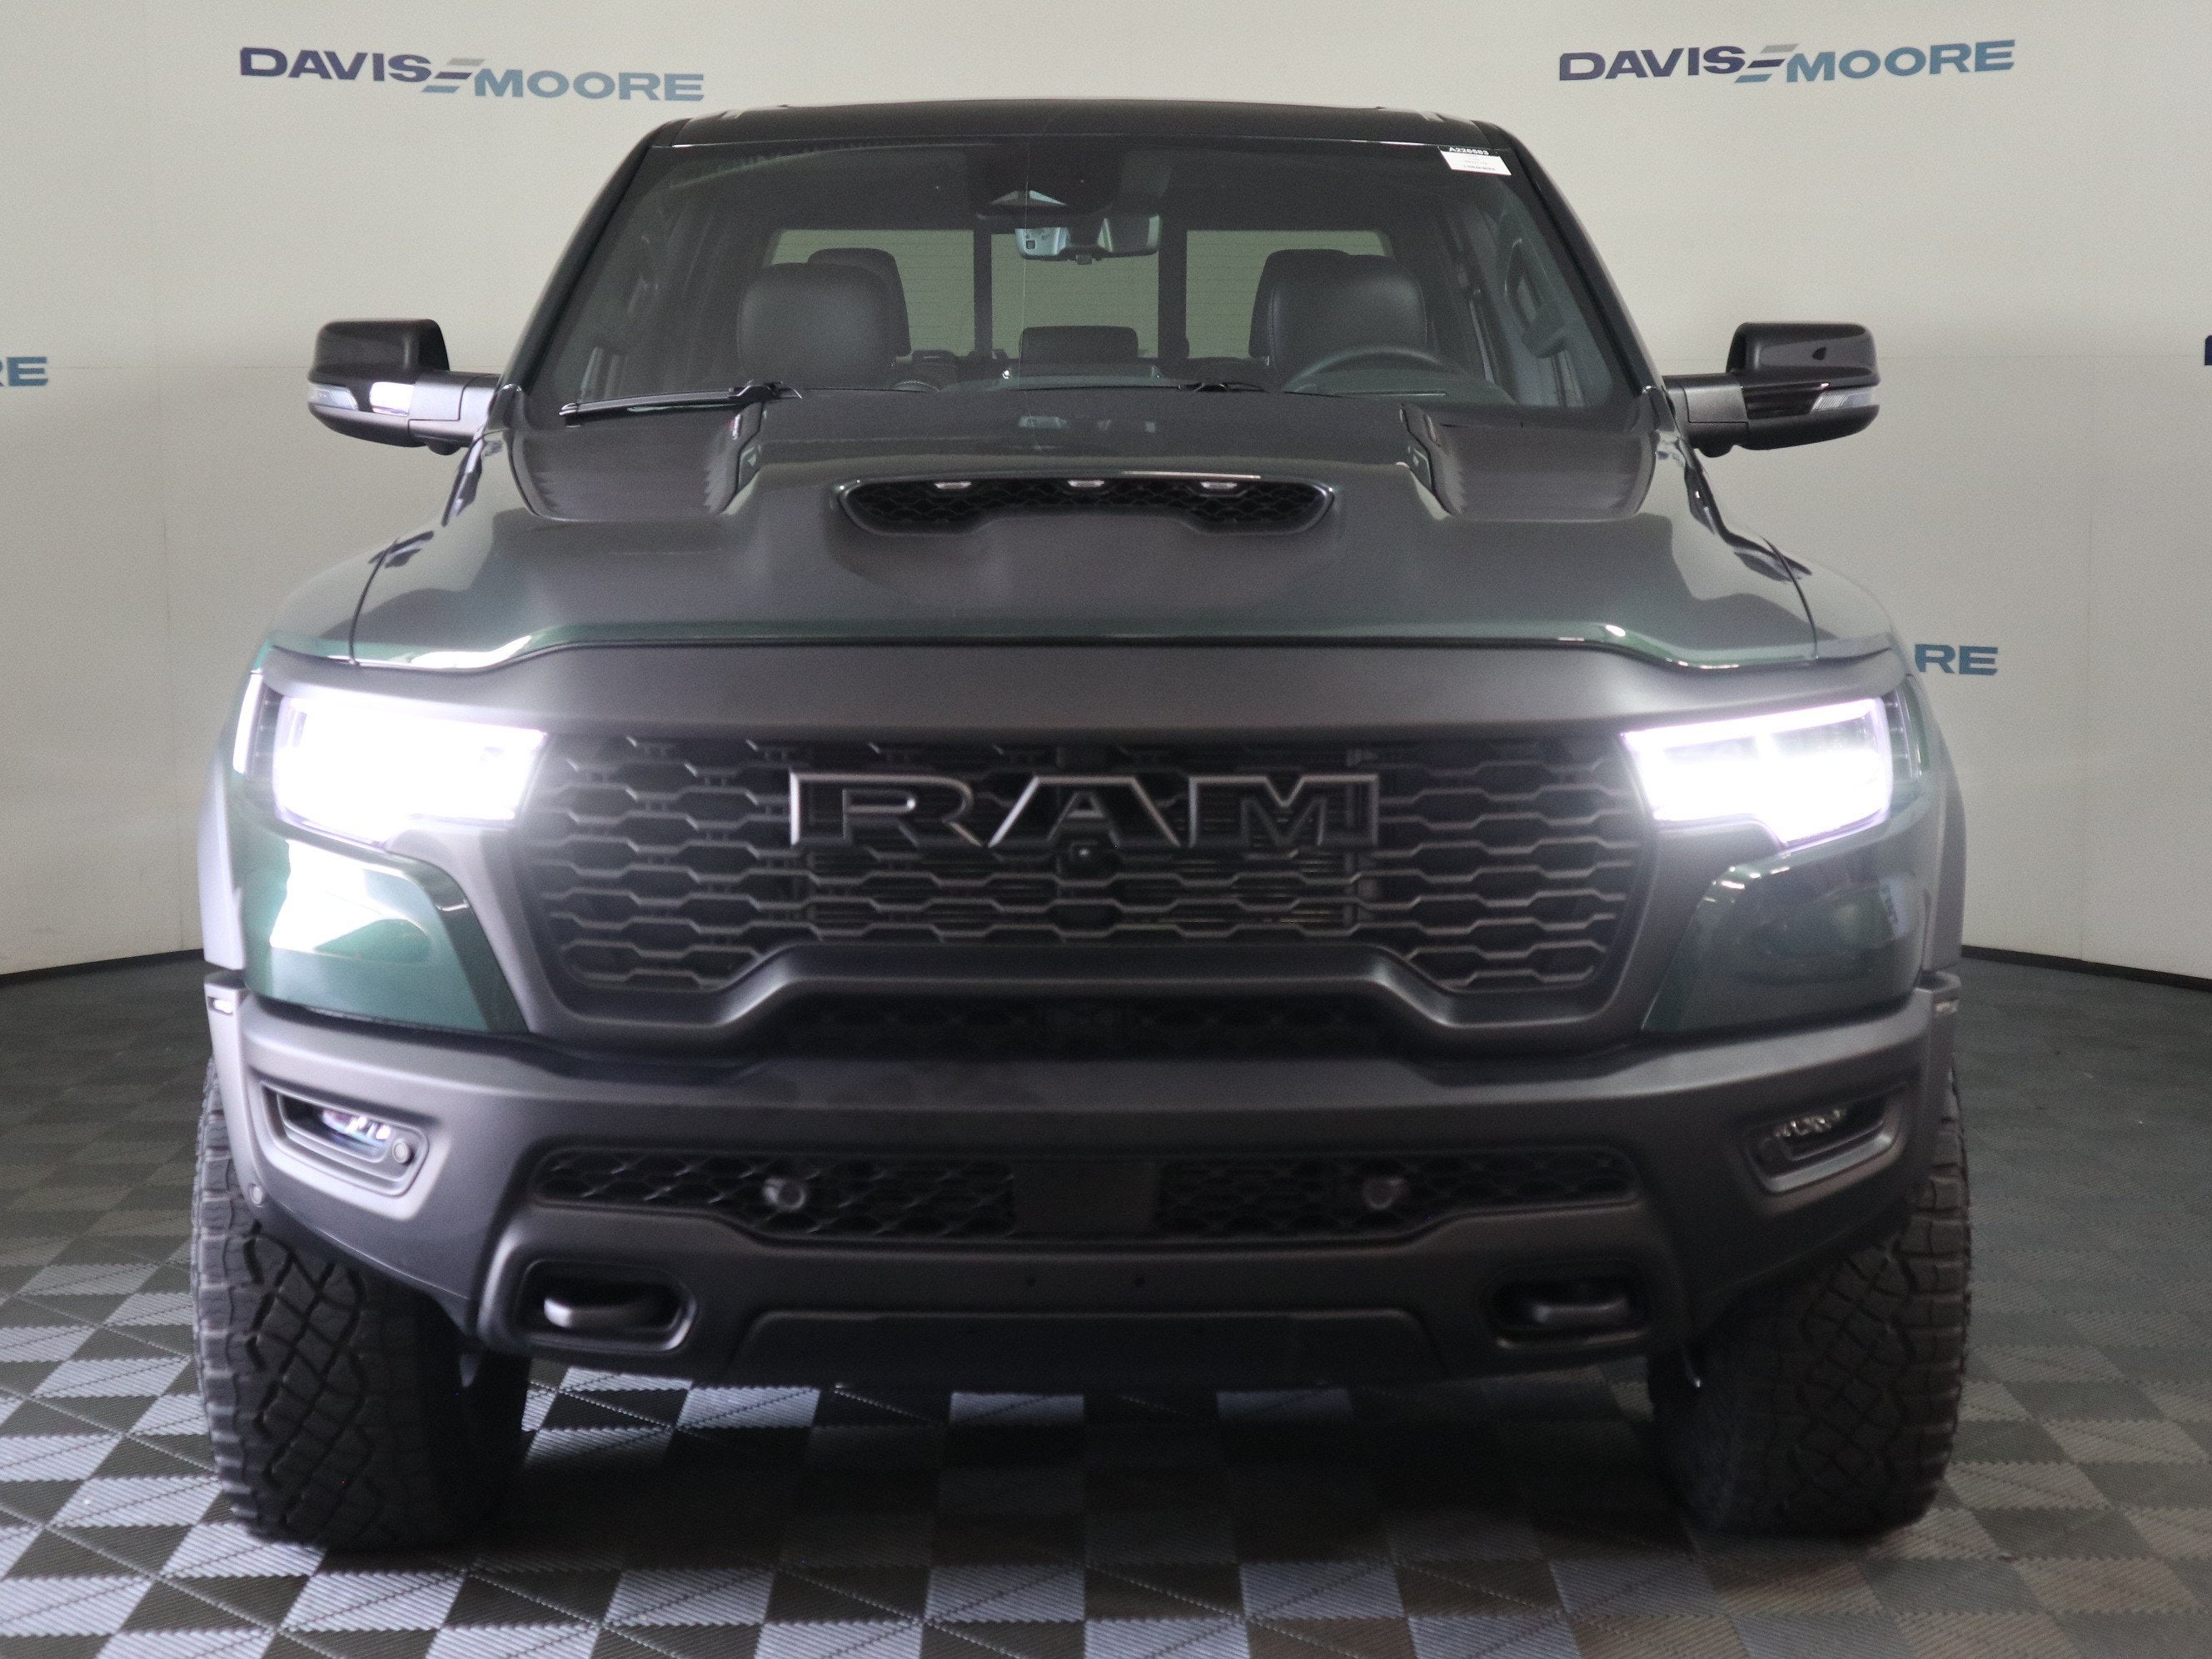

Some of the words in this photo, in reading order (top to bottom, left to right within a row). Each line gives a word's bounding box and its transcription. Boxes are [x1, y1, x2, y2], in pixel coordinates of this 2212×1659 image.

[239, 47, 431, 82] DAVIS
[473, 68, 705, 102] MOORE
[1558, 45, 1746, 82] DAVIS
[1786, 39, 2016, 83] MOORE
[789, 772, 1379, 848] RAM
